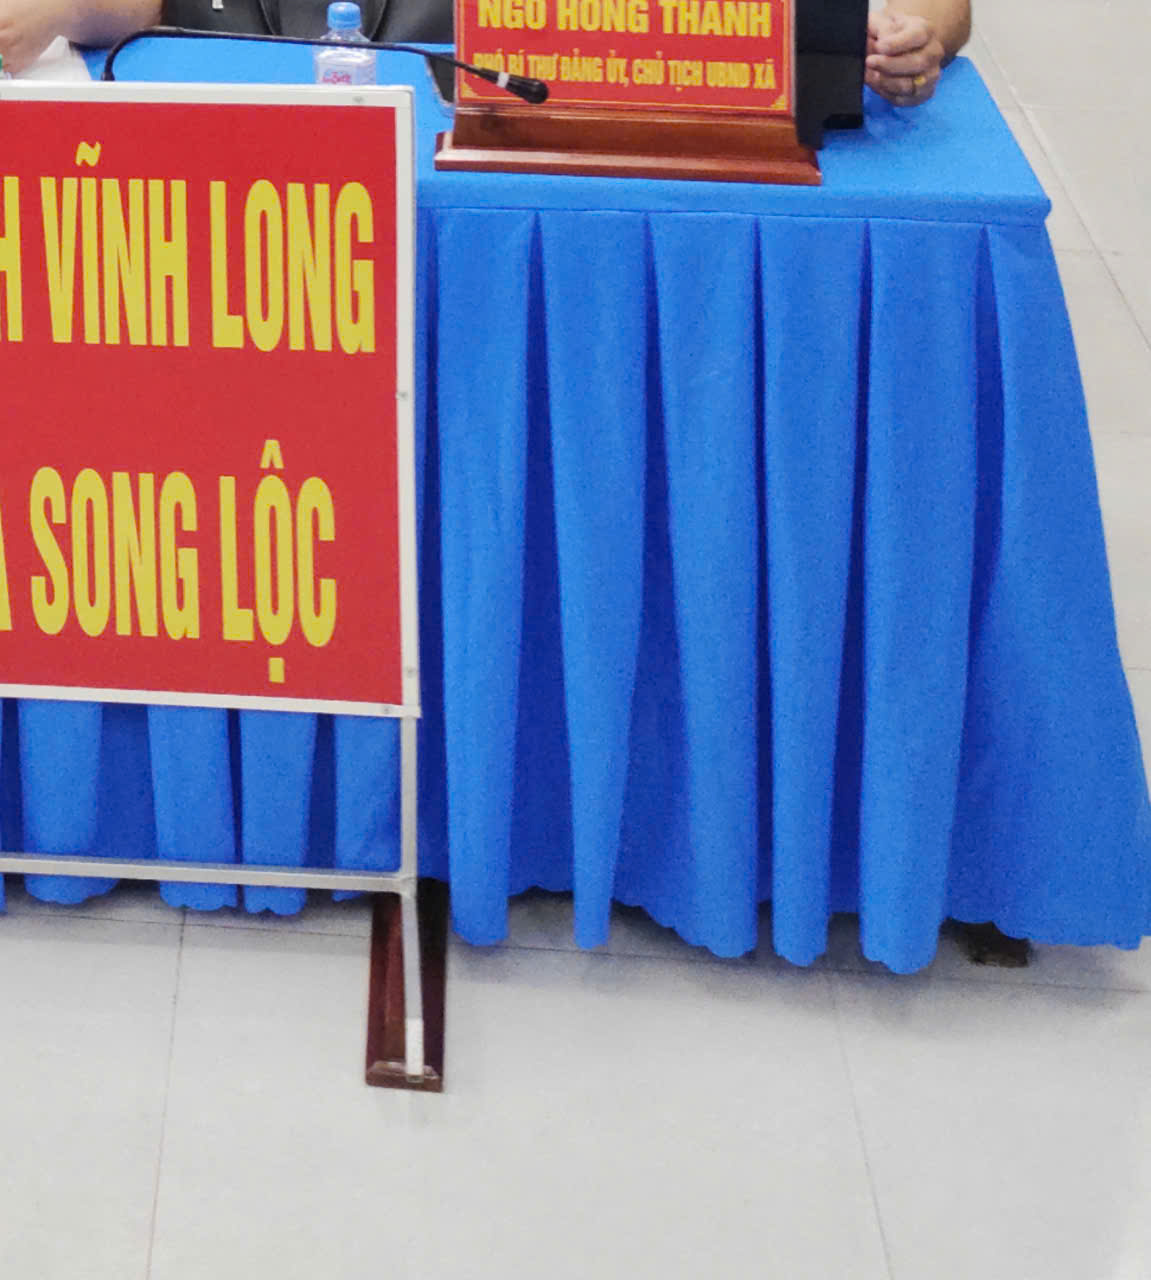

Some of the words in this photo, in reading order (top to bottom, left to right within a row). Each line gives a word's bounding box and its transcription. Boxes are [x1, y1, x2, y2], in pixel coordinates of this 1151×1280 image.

[527, 52, 559, 81] THƯ
[666, 59, 704, 93] TỊCH
[41, 143, 188, 346] VĨNH
[210, 181, 375, 354] LONG
[30, 467, 199, 640] SONG
[220, 440, 336, 682] LỘC
